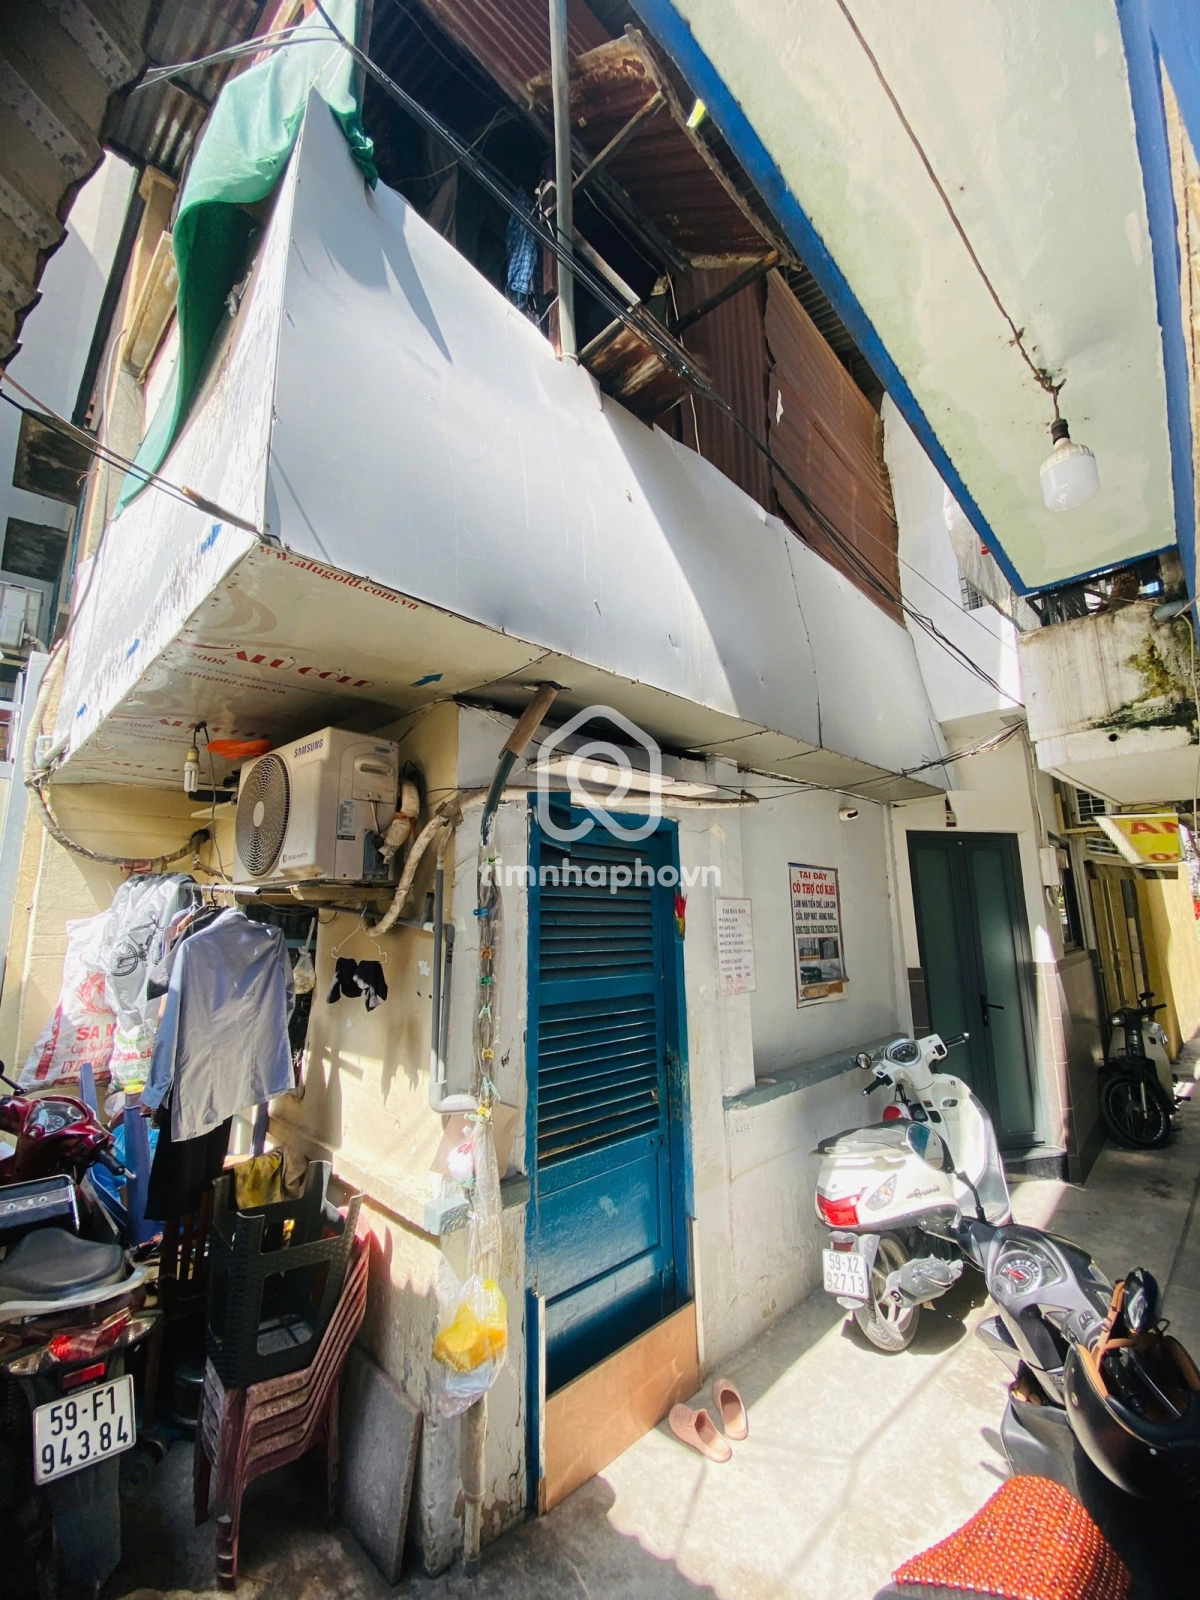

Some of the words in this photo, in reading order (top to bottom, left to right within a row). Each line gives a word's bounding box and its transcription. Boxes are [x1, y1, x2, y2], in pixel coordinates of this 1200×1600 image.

[188, 652, 228, 666] 2008
[293, 738, 324, 758] SAMSUNG
[798, 870, 811, 881] TẠI
[812, 870, 827, 881] ĐÂY
[792, 880, 801, 894] CÓ
[801, 882, 815, 896] THỢ
[815, 882, 824, 895] CƠ
[824, 882, 836, 896] KHÍ
[826, 1271, 865, 1294] 927.13
[50, 1386, 115, 1436] 59-F1
[41, 1415, 129, 1475] 943.84
